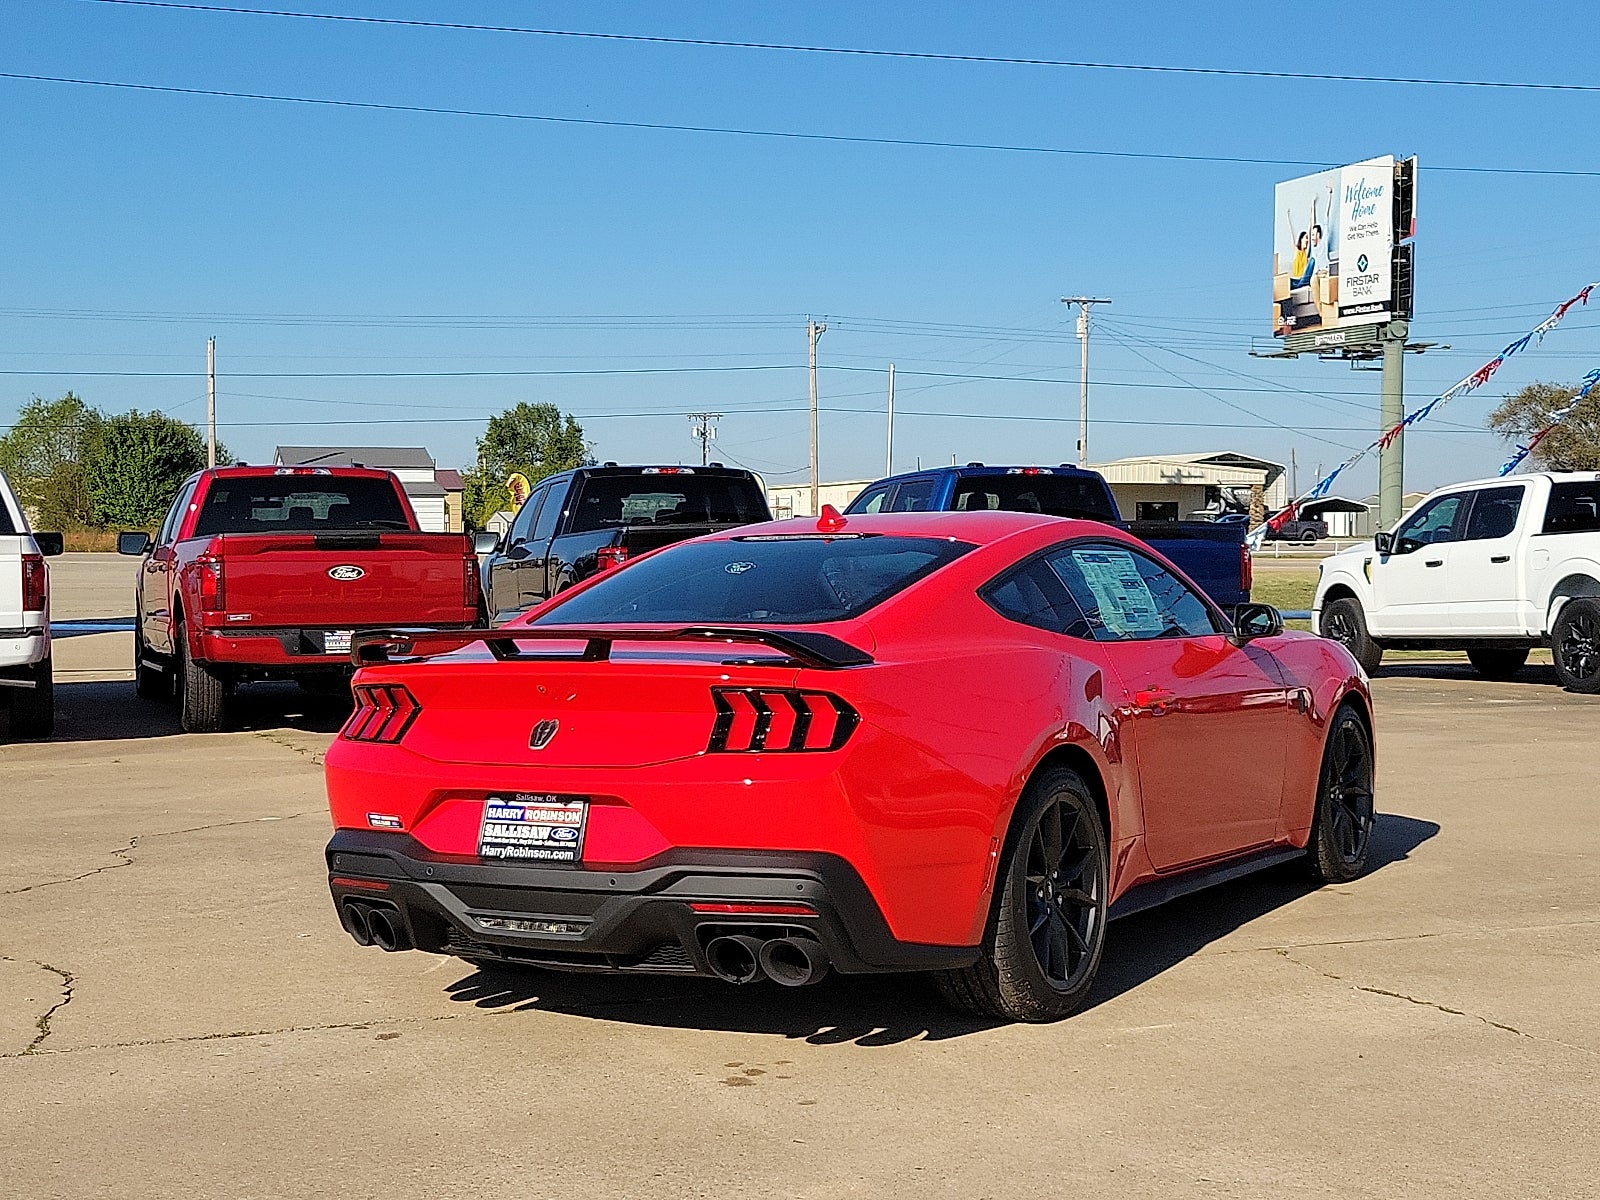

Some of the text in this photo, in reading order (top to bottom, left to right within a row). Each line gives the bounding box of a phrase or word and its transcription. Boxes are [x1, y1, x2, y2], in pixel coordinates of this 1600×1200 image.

[1345, 177, 1384, 203] Welcome
[1351, 201, 1376, 221] Home
[1346, 273, 1380, 288] FIRSTAR
[1352, 285, 1373, 297] BANK
[334, 567, 359, 578] Ford
[515, 793, 558, 803] Sallisaw, OK
[487, 807, 581, 823] HARRY ROBINSON
[484, 823, 552, 840] SALLISAW
